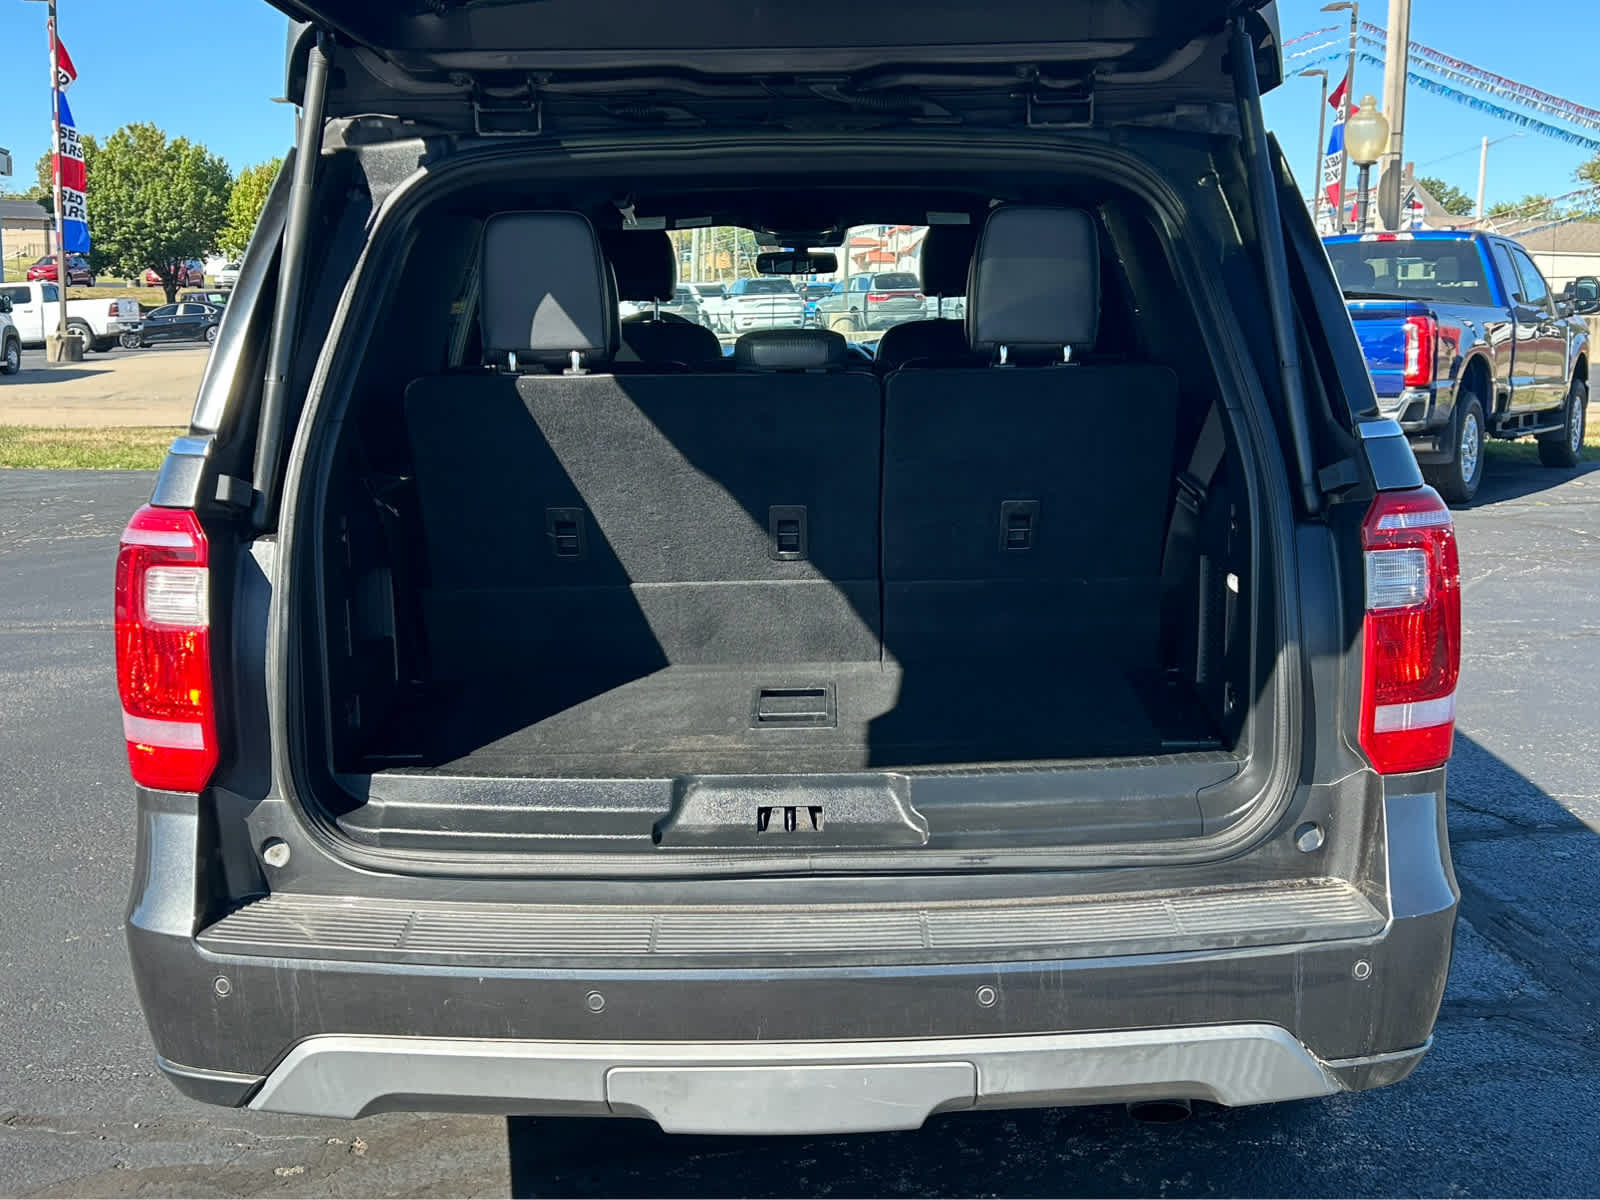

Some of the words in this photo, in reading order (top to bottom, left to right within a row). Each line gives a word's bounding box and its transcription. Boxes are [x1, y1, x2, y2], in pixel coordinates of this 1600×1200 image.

[60, 142, 83, 158] ARS
[62, 190, 84, 206] SED
[63, 205, 86, 221] ARS
